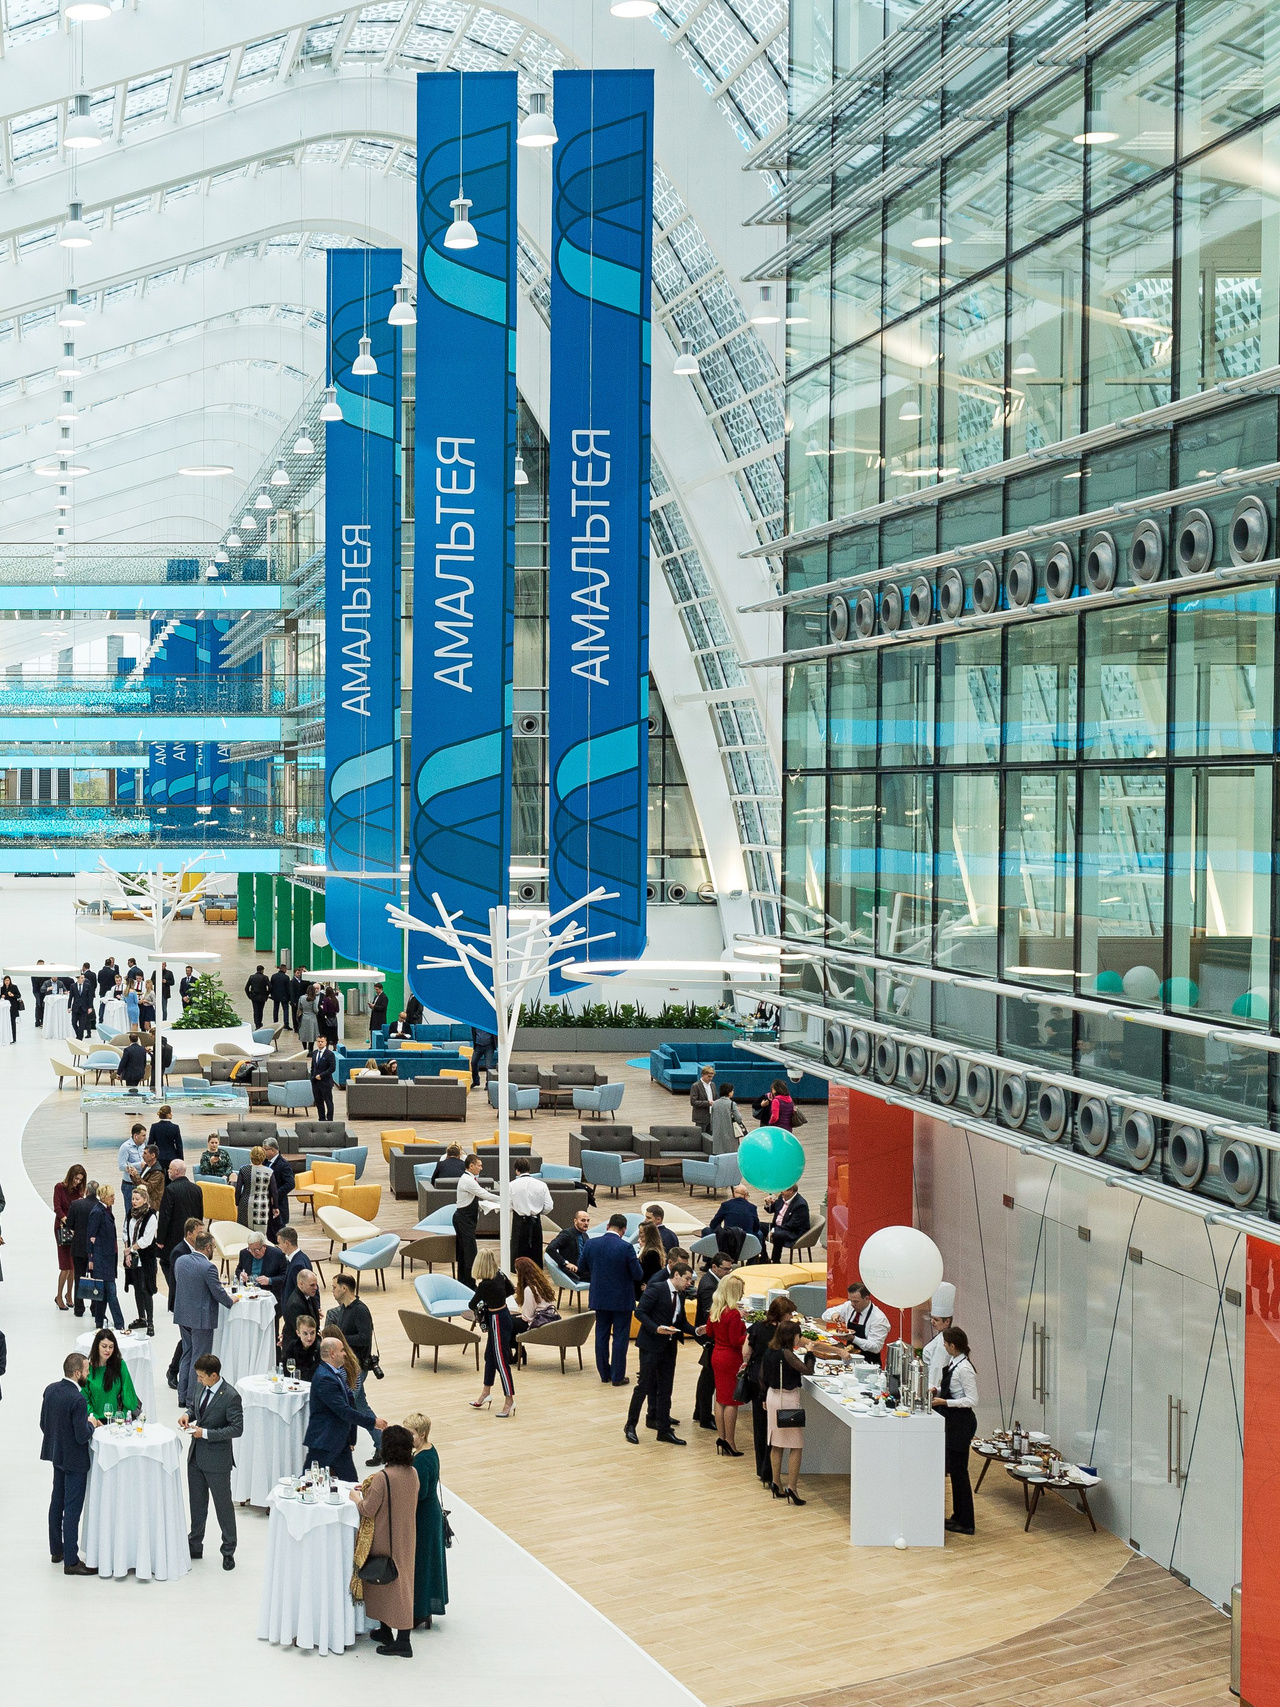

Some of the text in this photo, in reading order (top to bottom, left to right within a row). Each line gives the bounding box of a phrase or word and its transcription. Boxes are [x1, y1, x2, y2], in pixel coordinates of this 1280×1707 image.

[341, 525, 372, 716] АМАЛЬТЕЯ
[433, 436, 476, 693] АМАЛЬТЕЯ
[570, 429, 611, 686] АМАЛЬТЕЯ
